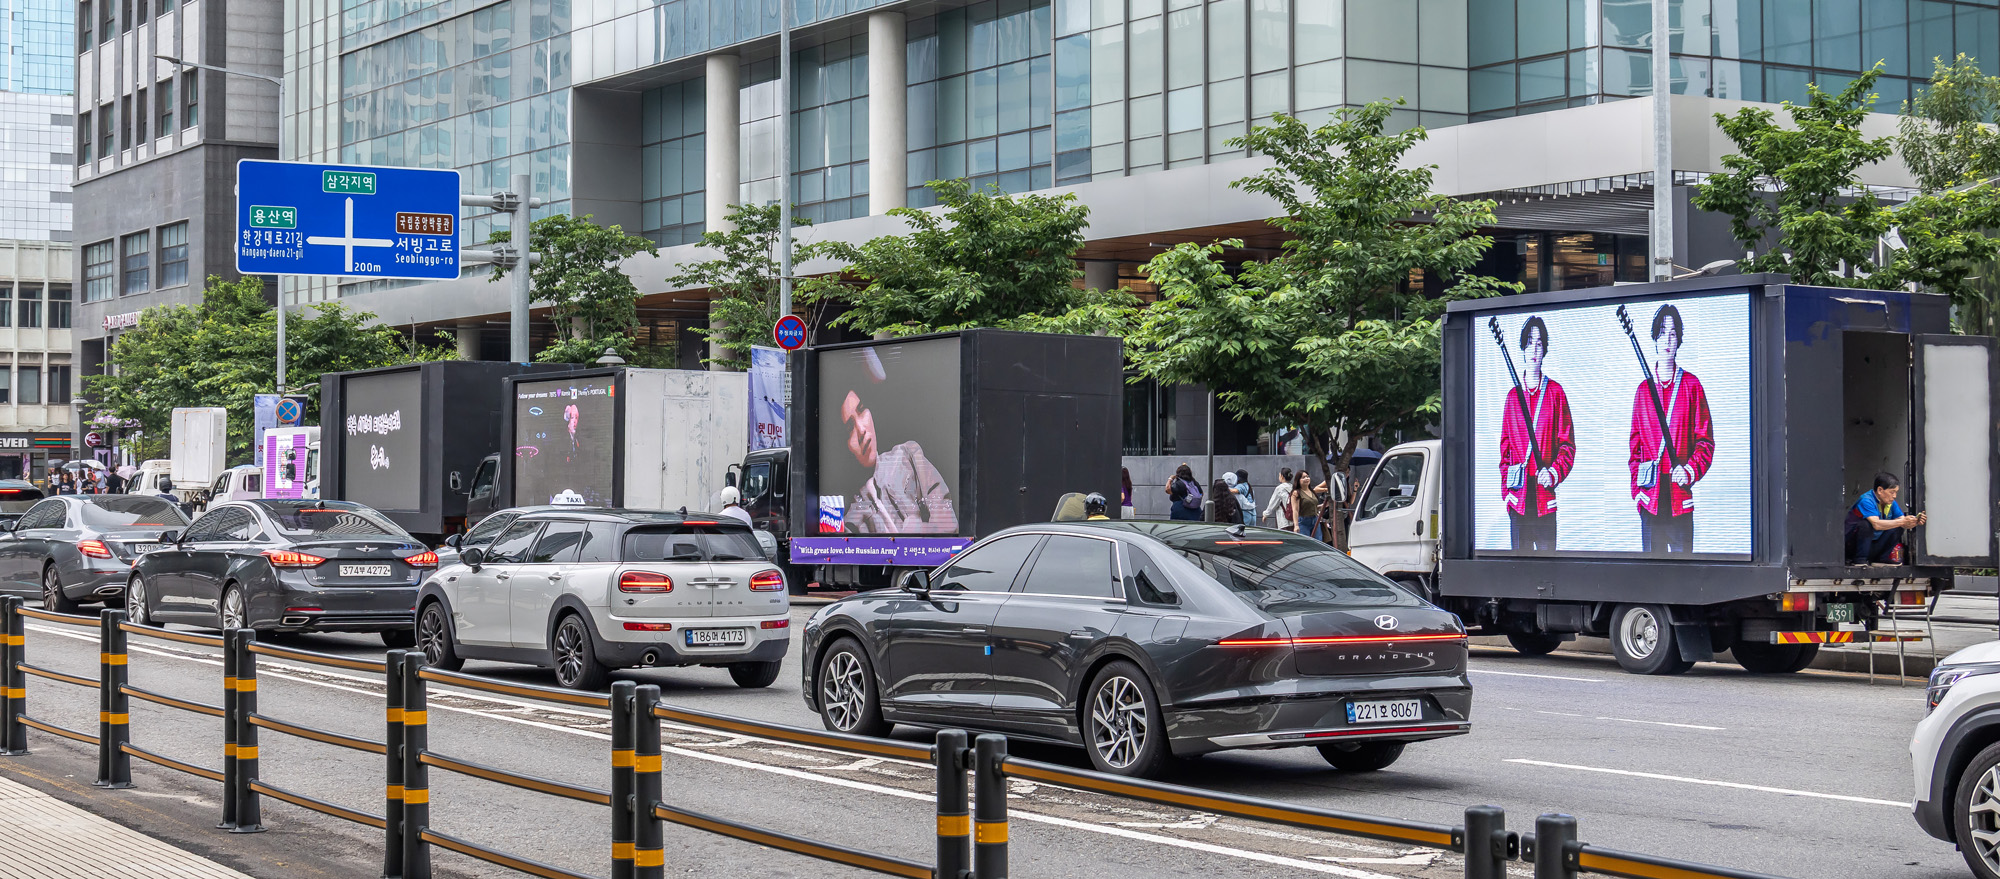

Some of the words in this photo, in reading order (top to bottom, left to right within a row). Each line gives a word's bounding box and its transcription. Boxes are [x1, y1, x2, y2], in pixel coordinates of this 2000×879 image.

[327, 174, 373, 191] 삼각지역
[253, 209, 294, 225] 용산역
[399, 215, 450, 233] 국립중앙박물관
[396, 236, 453, 254] 서빙고로
[241, 247, 286, 260] Hangang-daero
[286, 248, 303, 260] 21-gil
[395, 253, 454, 267] Seobinggo-ro
[354, 262, 382, 273] 200m
[814, 547, 829, 555] great
[830, 546, 844, 554] love,
[845, 546, 854, 554] the
[1828, 609, 1852, 621] 4391
[1338, 651, 1434, 660] GRANDEUR
[1390, 702, 1418, 718] 8067
